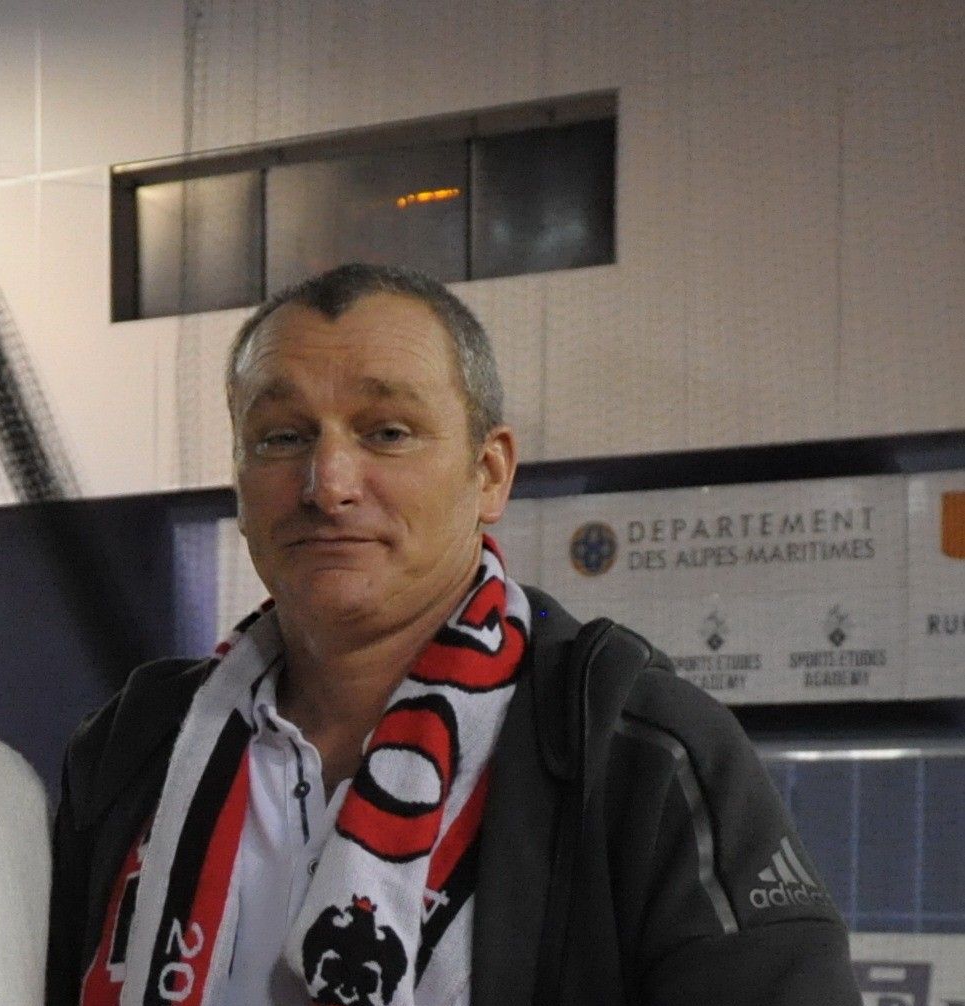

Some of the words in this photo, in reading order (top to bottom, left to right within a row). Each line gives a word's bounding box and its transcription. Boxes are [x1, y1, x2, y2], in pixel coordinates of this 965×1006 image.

[626, 506, 875, 544] DEPARTEMENT
[628, 550, 667, 571] DES
[926, 613, 965, 635] RU
[670, 655, 714, 672] PORTS
[749, 881, 832, 909] adid
